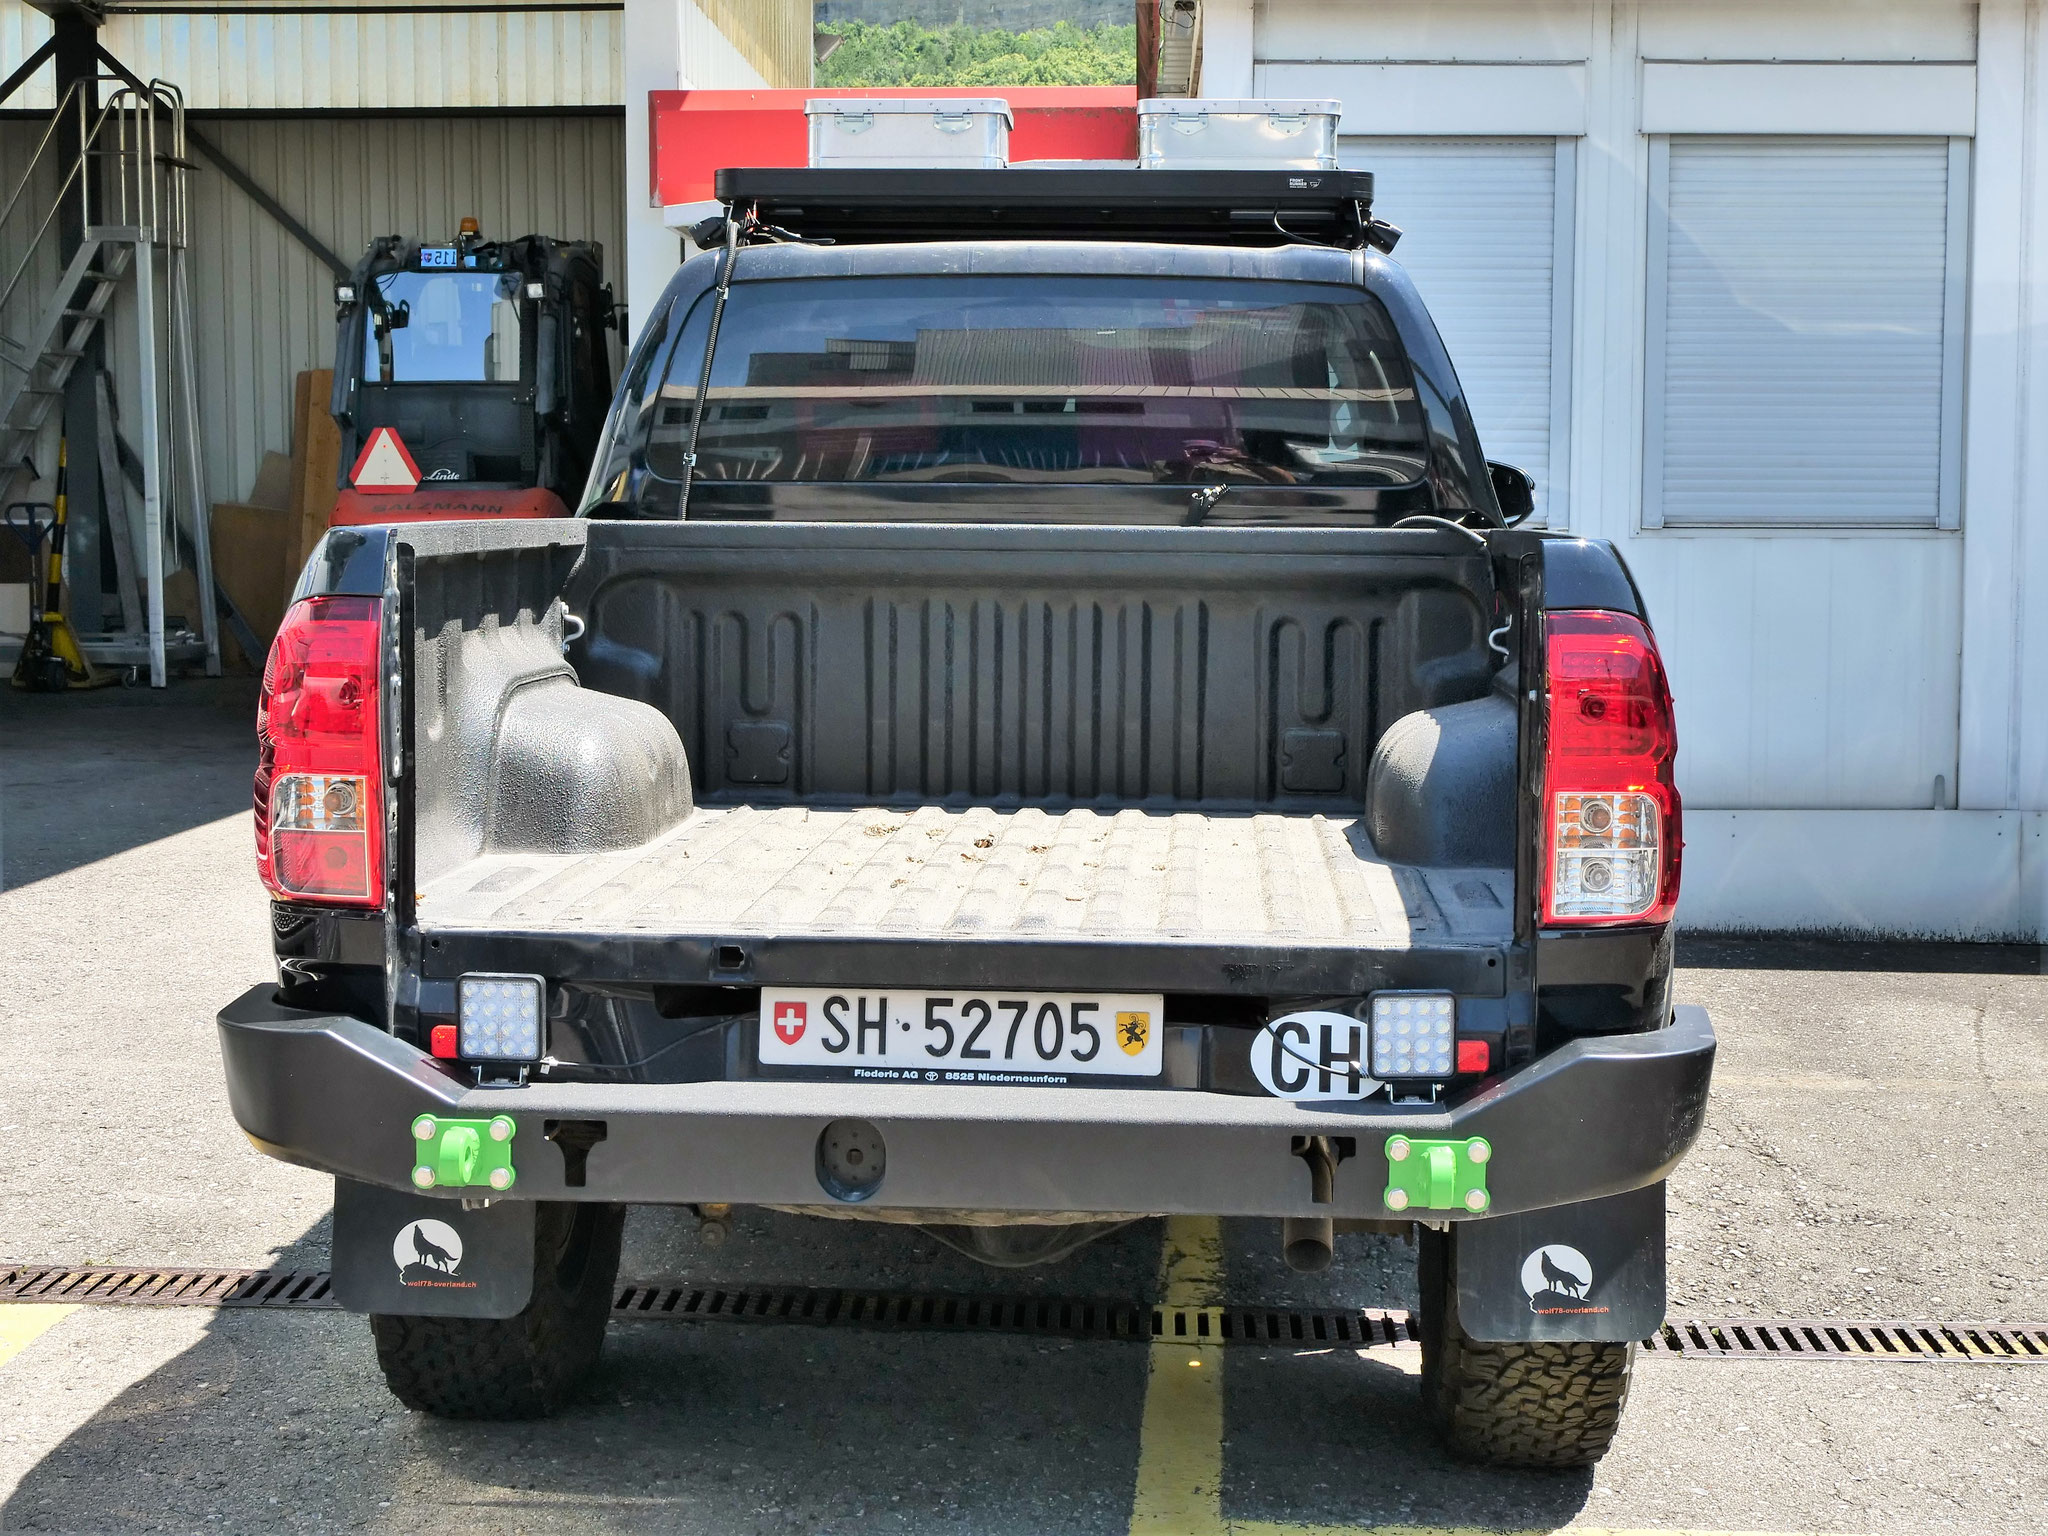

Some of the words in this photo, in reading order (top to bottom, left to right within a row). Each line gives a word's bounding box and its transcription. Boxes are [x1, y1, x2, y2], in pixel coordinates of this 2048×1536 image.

[422, 468, 460, 481] Linde
[371, 502, 503, 515] SALZMANN
[924, 997, 1101, 1063] 52705
[1271, 1021, 1361, 1094] CH
[854, 1069, 899, 1079] Fiederle
[902, 1071, 919, 1079] AG
[945, 1072, 975, 1081] 8525
[978, 1073, 1068, 1084] Niederneunforn
